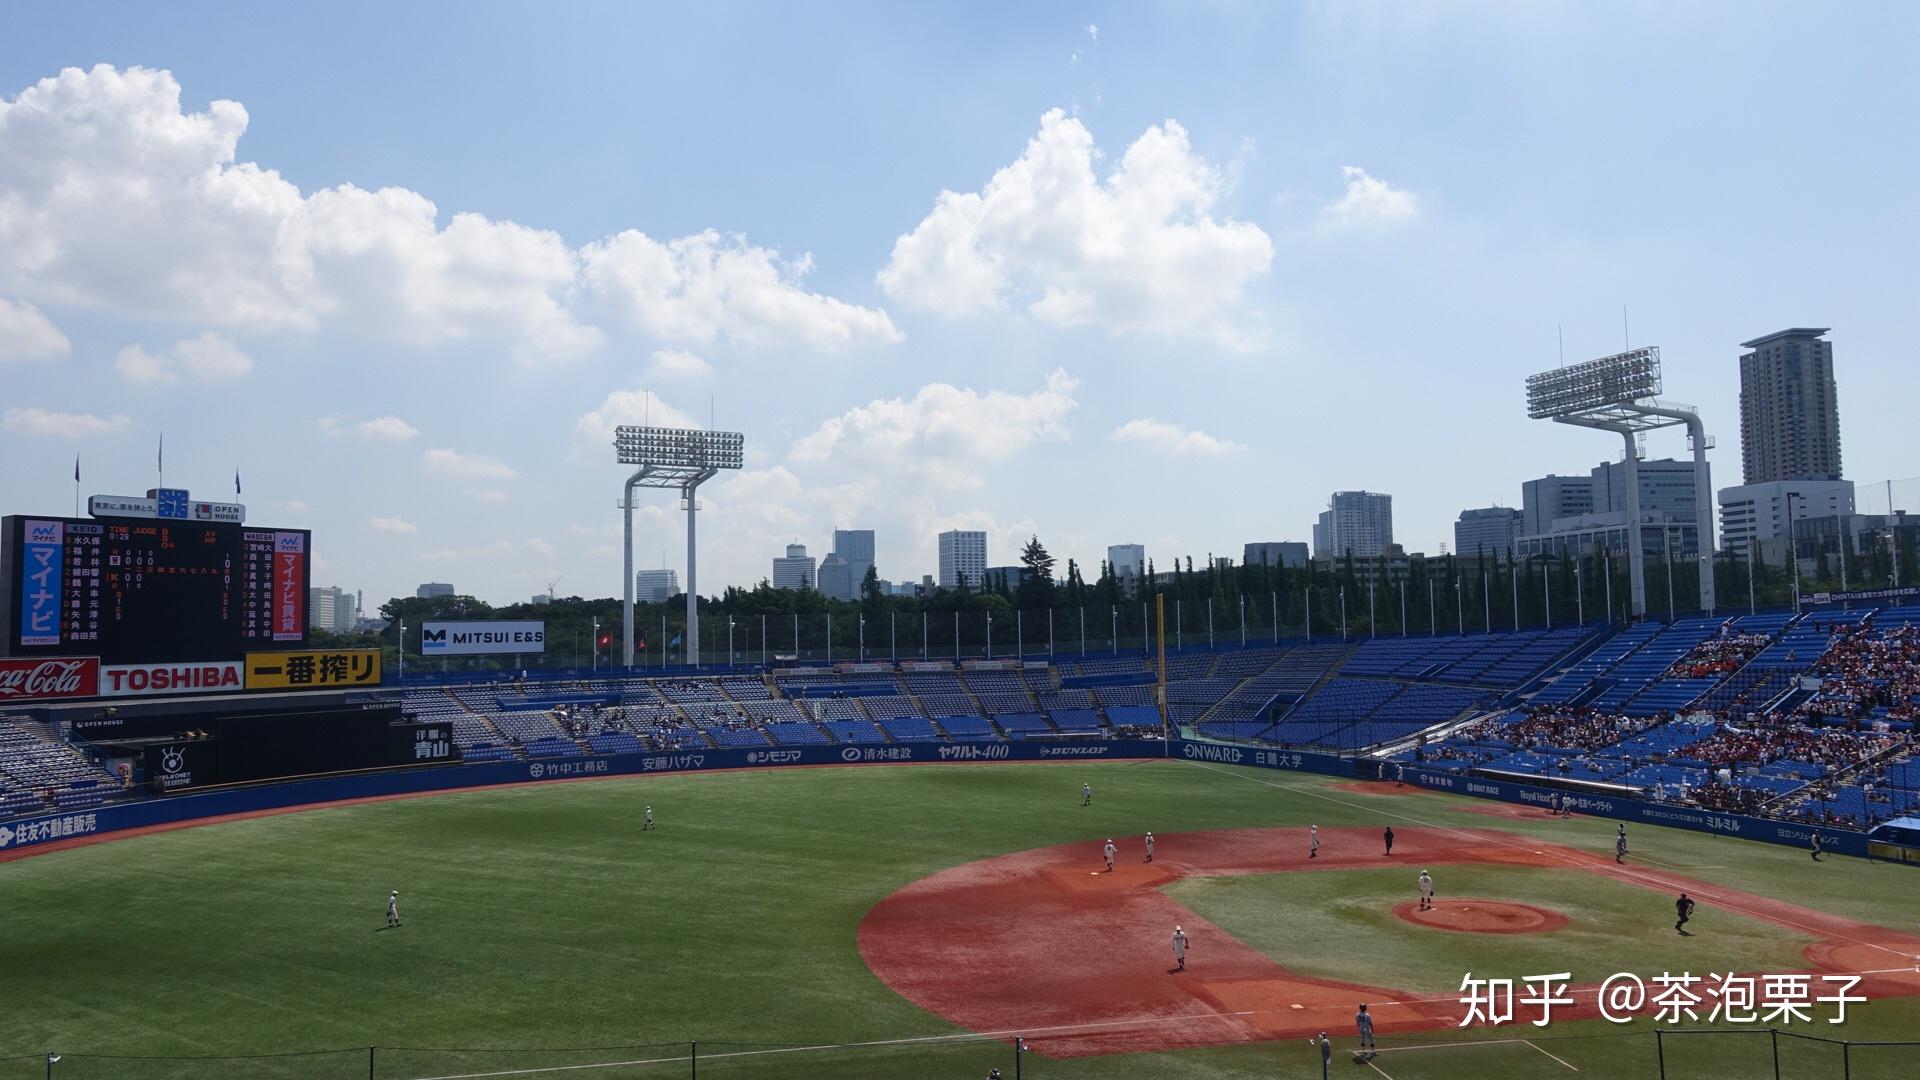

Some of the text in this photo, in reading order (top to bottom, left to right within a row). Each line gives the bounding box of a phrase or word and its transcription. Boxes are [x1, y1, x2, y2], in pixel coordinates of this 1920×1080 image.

[125, 556, 131, 565] 0
[136, 556, 142, 565] 0
[147, 557, 153, 565] 0
[224, 559, 230, 568] 0
[125, 573, 131, 582] 0
[136, 573, 142, 582] 0
[224, 574, 230, 584] 0
[30, 547, 55, 632] マイナビ
[282, 554, 296, 632] マイナビ賃貸
[453, 632, 509, 644] MITSUI
[514, 631, 544, 643] E&S
[254, 655, 374, 684] 一番搾り
[107, 666, 240, 691] TOSHIBA
[416, 729, 448, 740] 洋服の
[414, 740, 449, 758] 青山
[758, 751, 802, 762] シモジマ
[864, 748, 911, 760] 清水建設
[938, 744, 1010, 759] ヤクルト400
[1050, 745, 1108, 755] DUNLOP
[1184, 744, 1243, 762] ONWARD
[547, 760, 608, 775] 竹中工務店
[642, 755, 704, 771] 安藤ハザマ
[1473, 784, 1500, 795] BOAT RACE
[1520, 789, 1551, 802] Royal Host
[15, 813, 97, 844] 住友不動産販売
[1706, 816, 1741, 832] ミルミル
